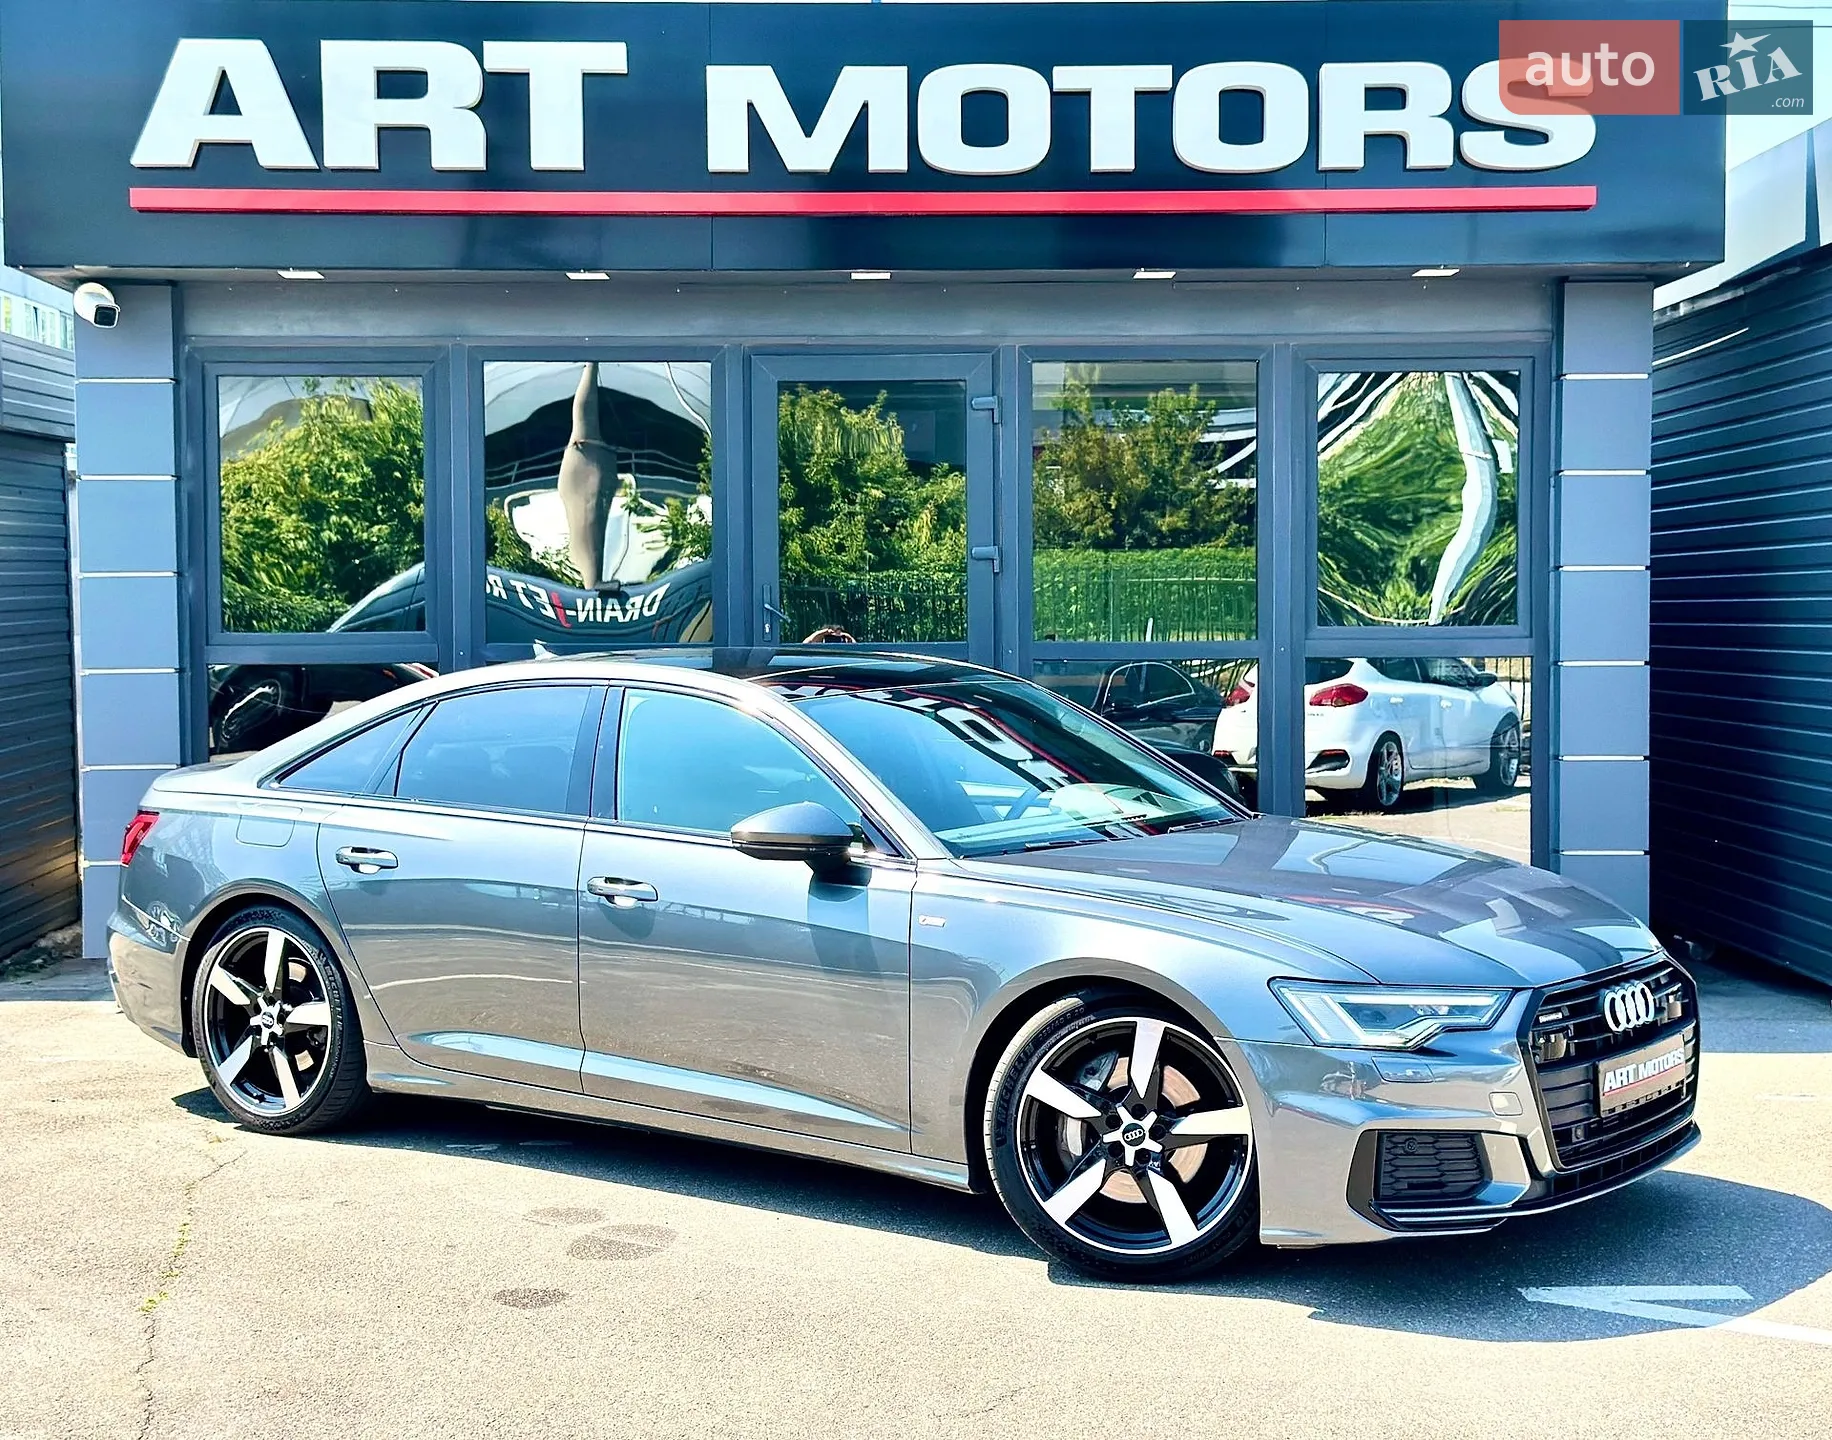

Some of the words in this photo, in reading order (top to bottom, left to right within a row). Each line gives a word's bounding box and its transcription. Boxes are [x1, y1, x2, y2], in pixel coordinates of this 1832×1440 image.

[129, 38, 628, 172] ART
[704, 59, 1597, 175] MOTORS
[1603, 1063, 1637, 1093] ART
[1638, 1047, 1685, 1079] MOTORS
